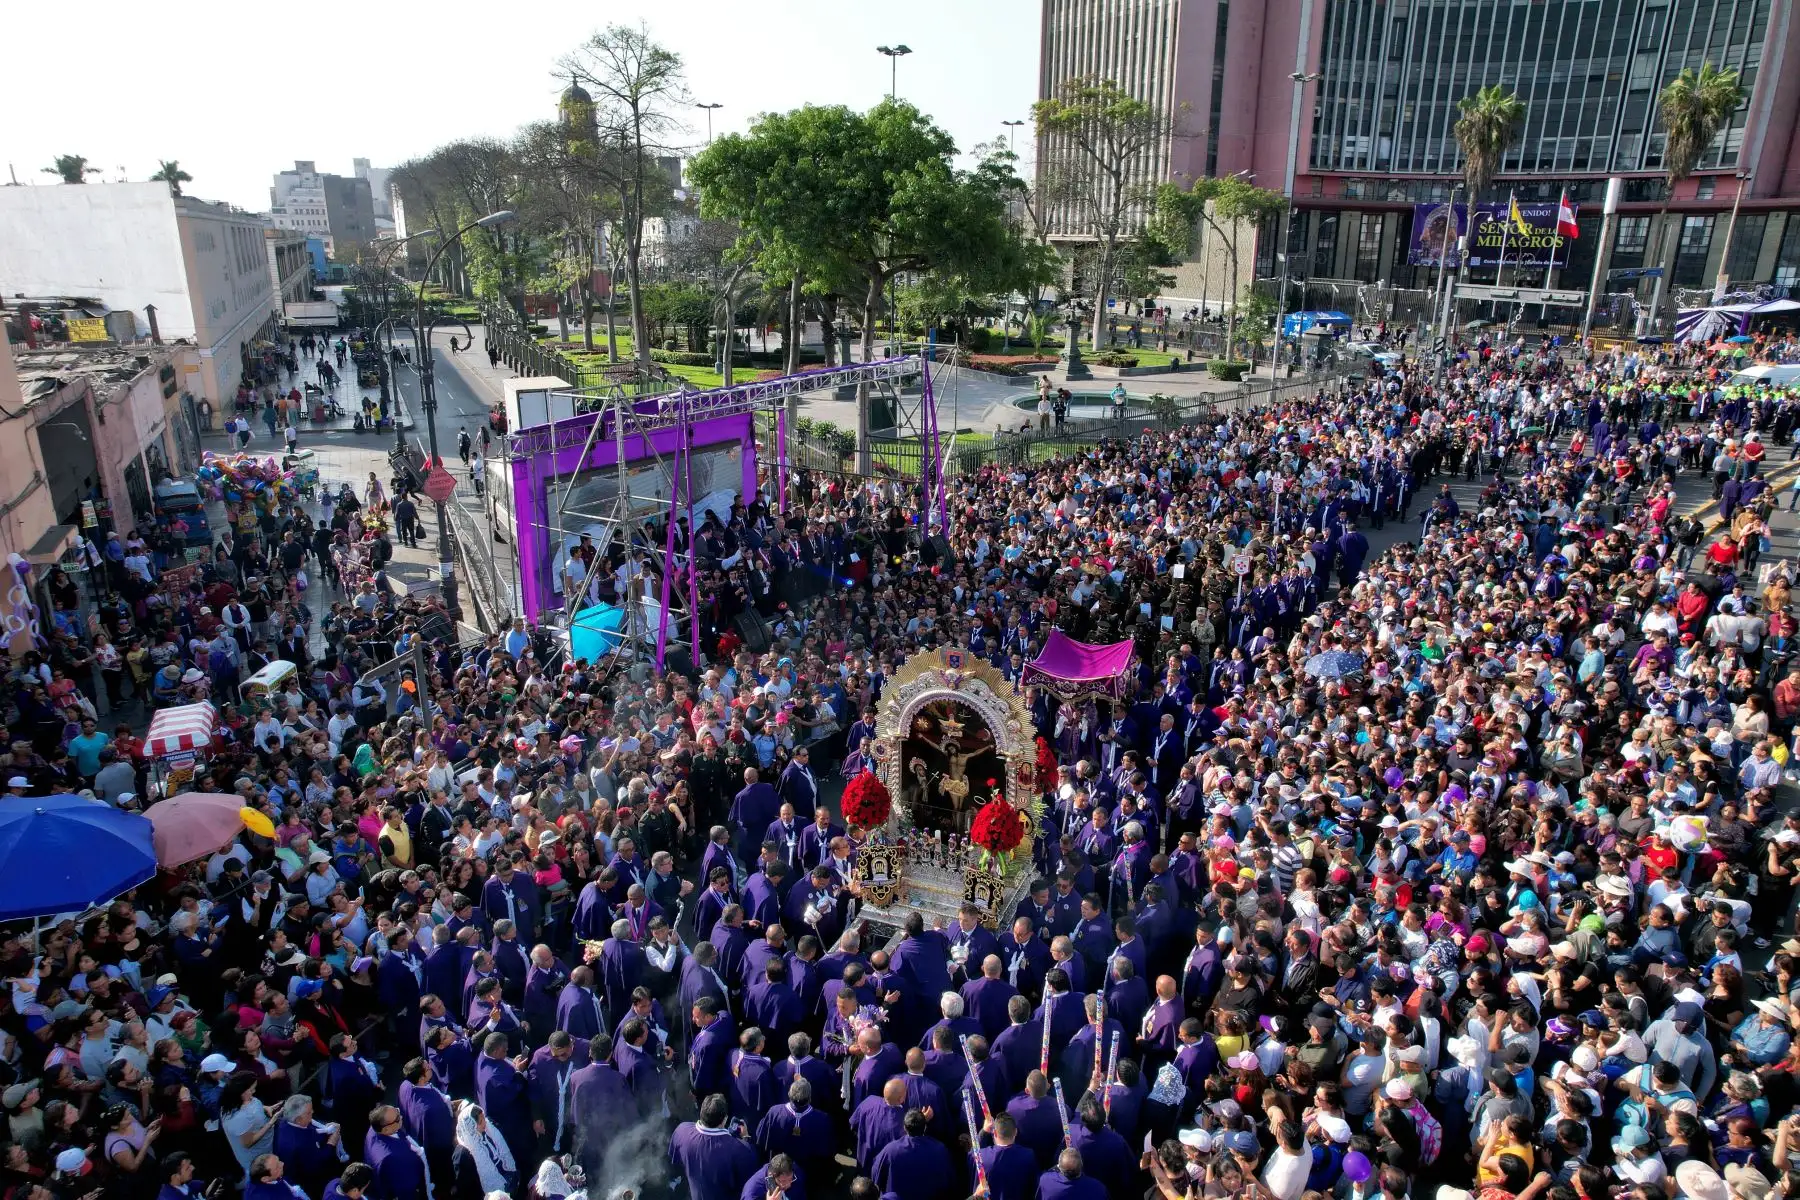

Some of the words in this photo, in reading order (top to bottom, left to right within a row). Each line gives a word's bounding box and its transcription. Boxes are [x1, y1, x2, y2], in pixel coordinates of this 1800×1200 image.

[1478, 220, 1533, 235] SEÑOR
[1534, 227, 1546, 235] DE
[1476, 234, 1564, 248] MILAGROS
